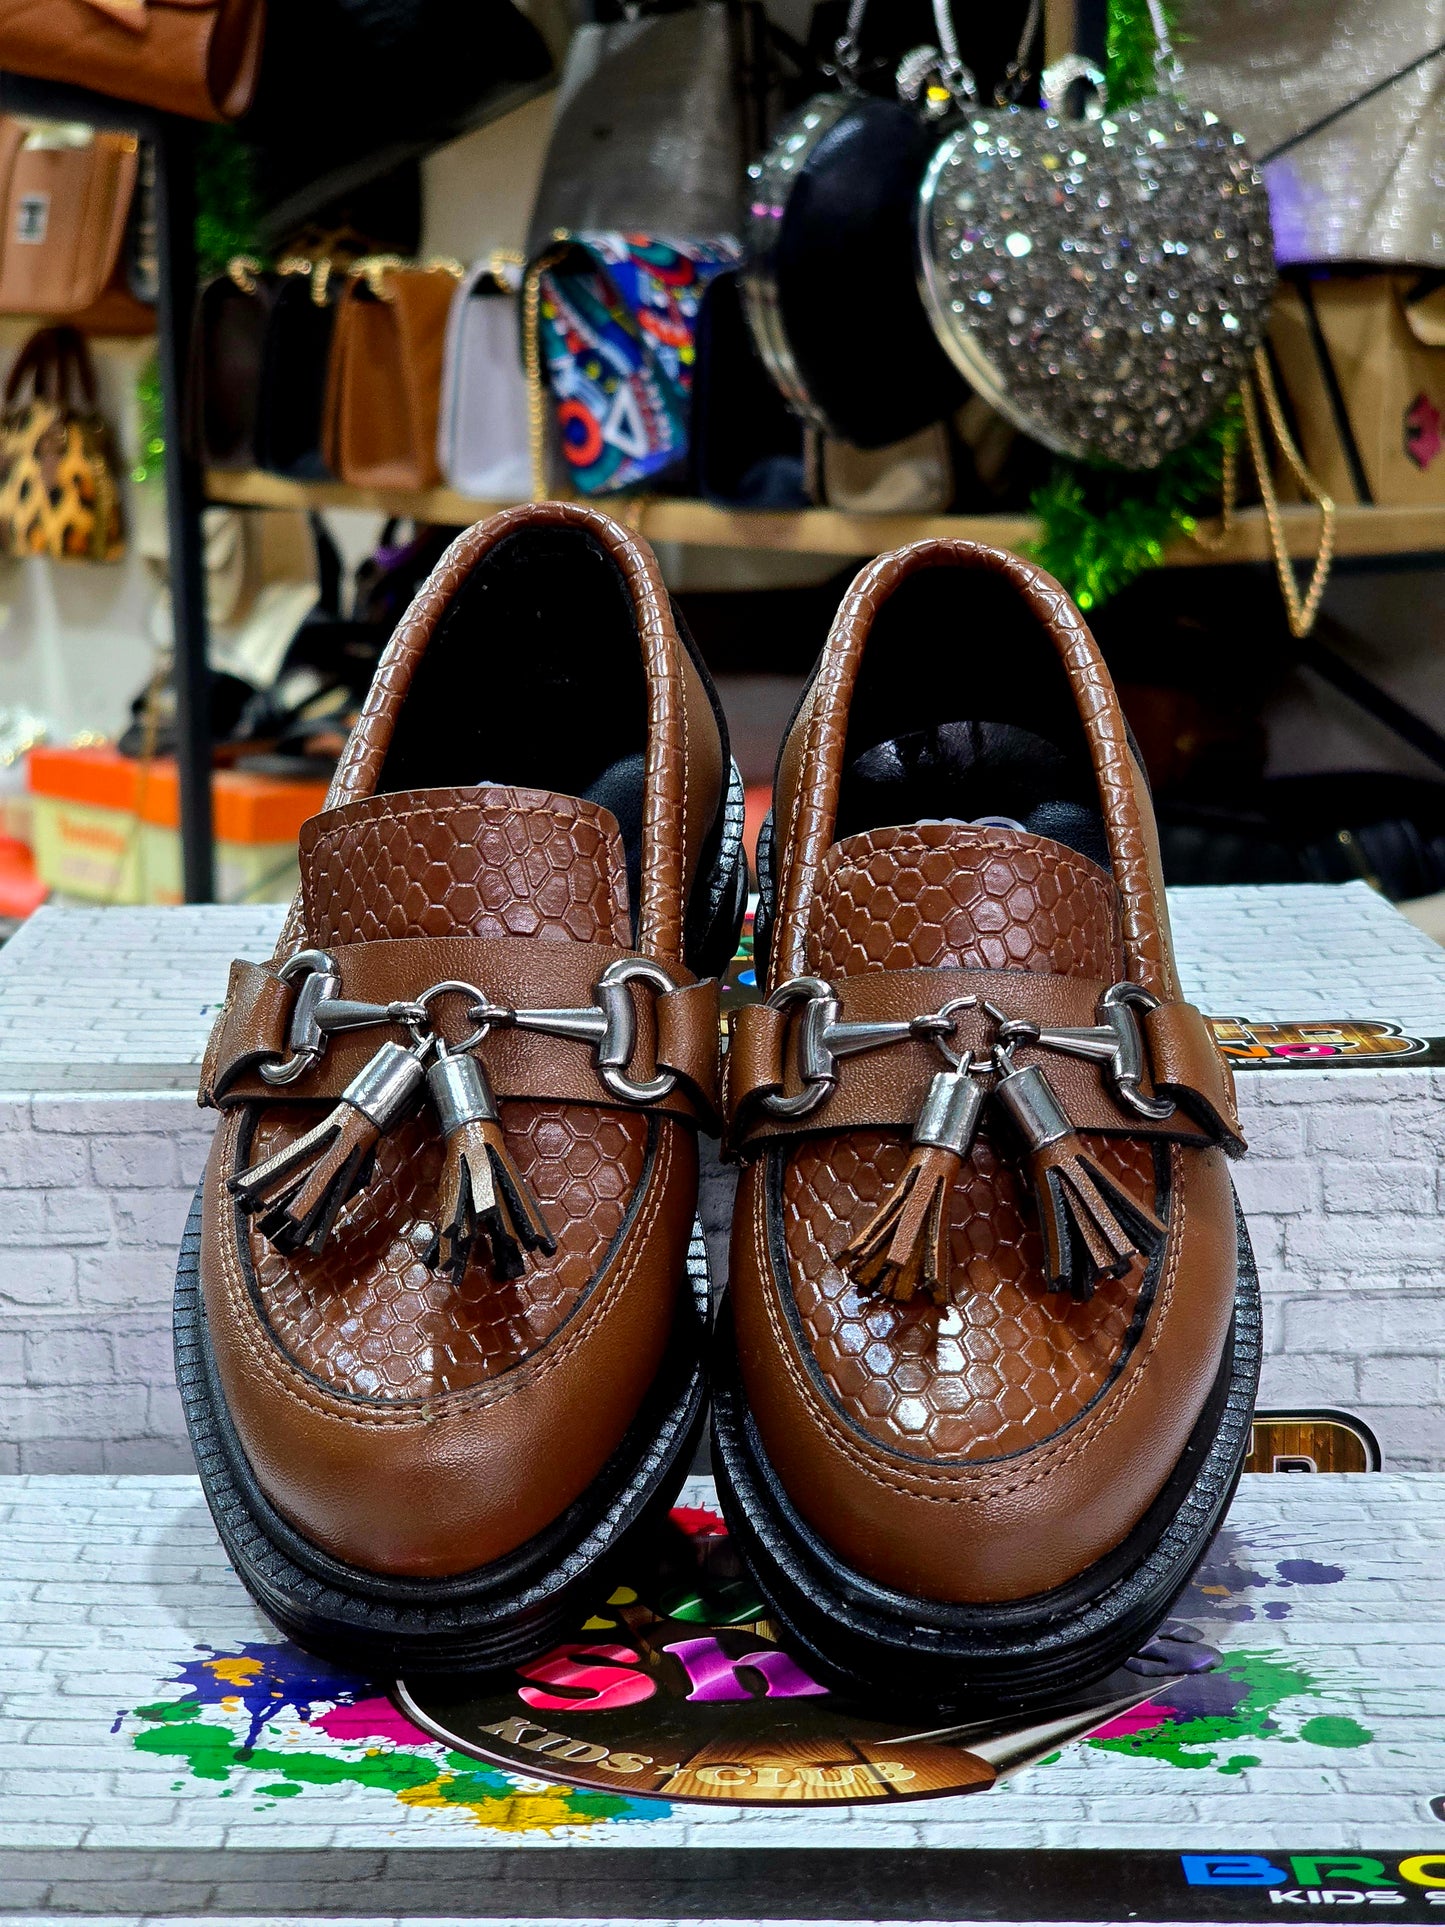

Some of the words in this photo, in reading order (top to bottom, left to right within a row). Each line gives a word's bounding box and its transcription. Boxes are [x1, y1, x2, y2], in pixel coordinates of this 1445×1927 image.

[478, 1716, 654, 1774] KIDS
[695, 1761, 916, 1788] CLUB
[1268, 1890, 1407, 1905] KIDS
